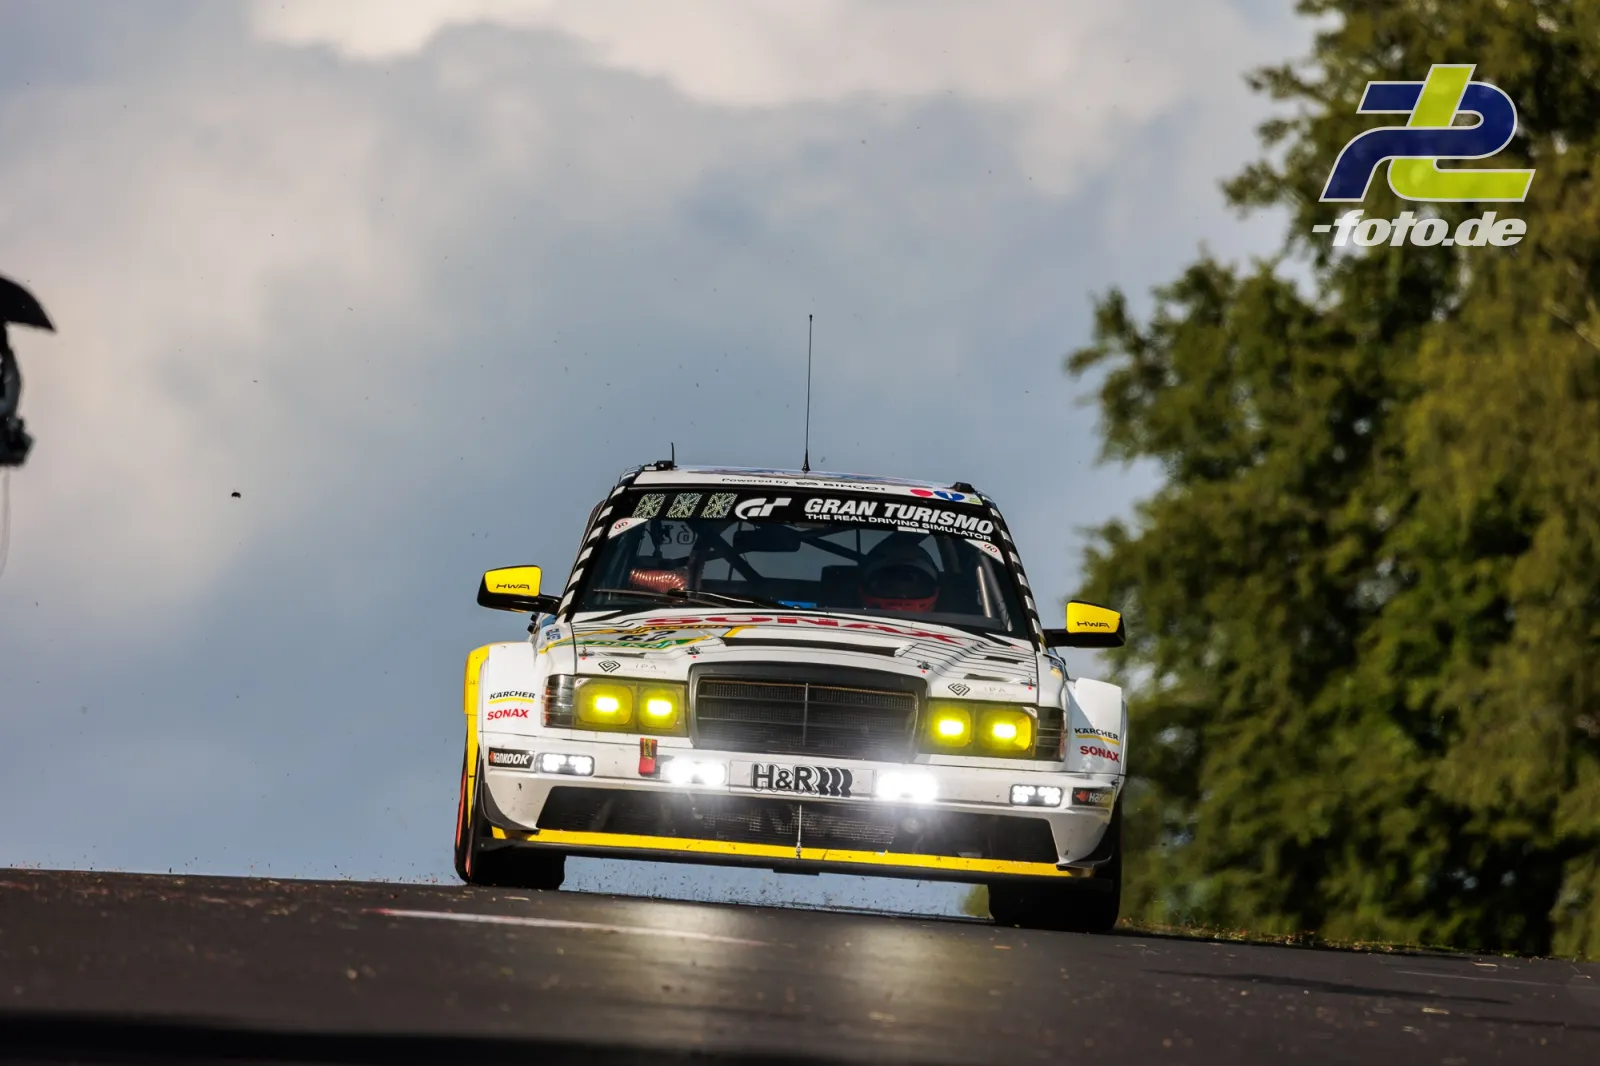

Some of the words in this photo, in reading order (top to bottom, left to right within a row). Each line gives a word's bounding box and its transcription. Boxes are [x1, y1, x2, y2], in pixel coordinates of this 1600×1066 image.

[804, 498, 878, 520] GRAN
[884, 502, 994, 535] TURISMO
[805, 513, 832, 521] THE
[833, 514, 867, 523] REAL
[868, 516, 920, 528] DRIVING
[921, 522, 992, 542] SIMULATOR
[1076, 621, 1111, 629] HWA
[487, 708, 530, 721] SONAX
[1080, 745, 1120, 763] SONAX
[752, 763, 820, 793] H&R
